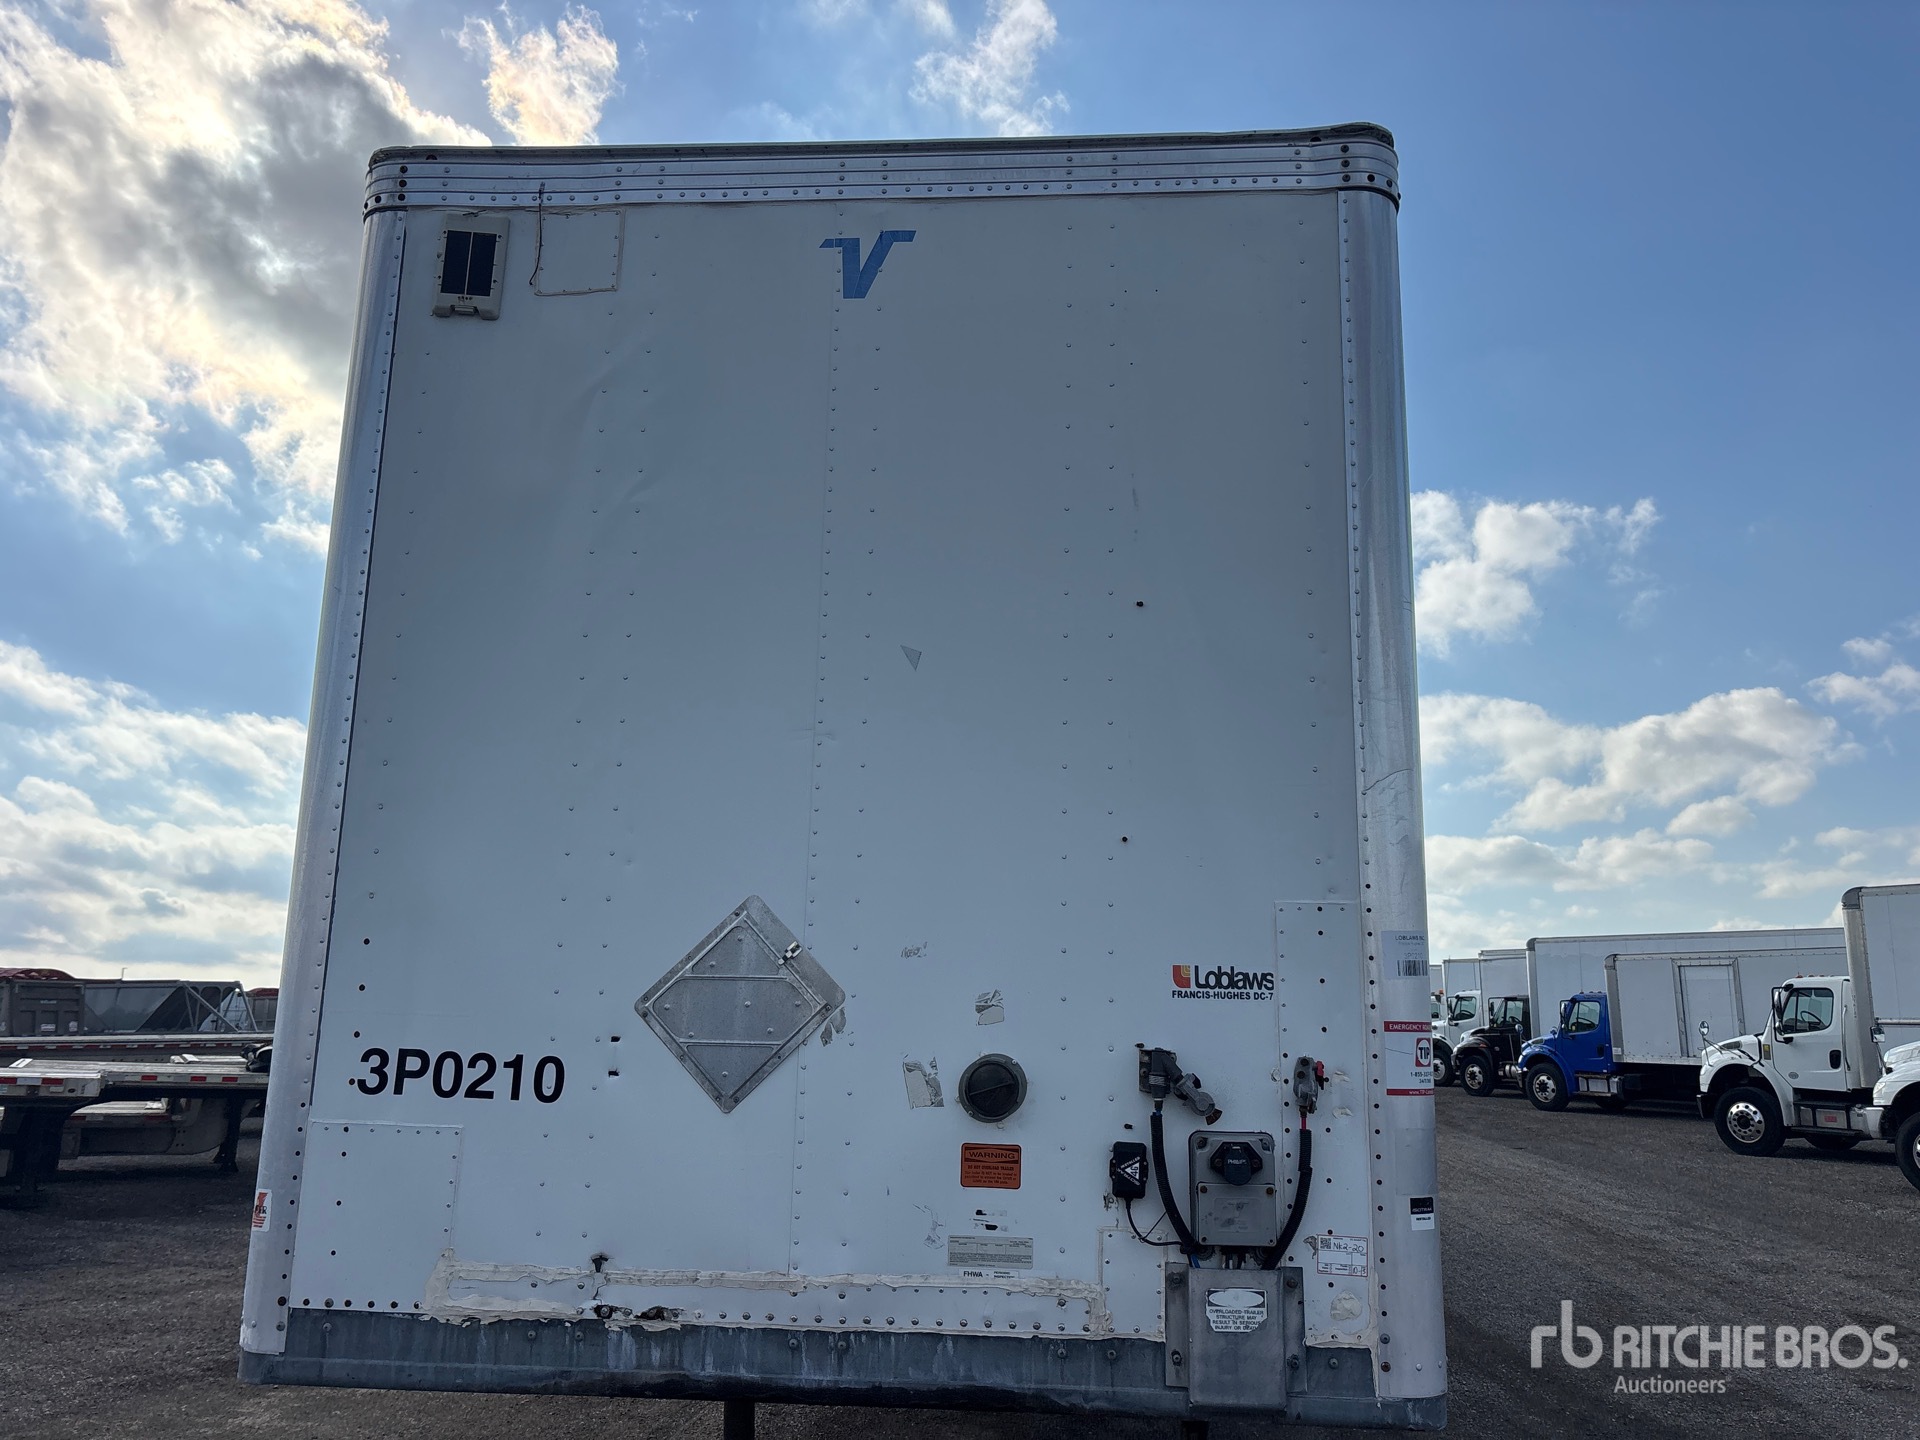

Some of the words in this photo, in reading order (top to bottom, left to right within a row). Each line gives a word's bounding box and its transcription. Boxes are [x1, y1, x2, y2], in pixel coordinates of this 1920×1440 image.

[1194, 965, 1275, 991] Loblaws
[1172, 990, 1251, 1000] FRANCIS-HUGHES
[1253, 992, 1274, 1001] DC-7
[1389, 1023, 1422, 1031] EMERGENCY
[1418, 1047, 1430, 1060] TIP
[357, 1047, 565, 1103] 3P0210
[969, 1151, 1016, 1160] WARNING
[963, 1270, 983, 1278] FHWA
